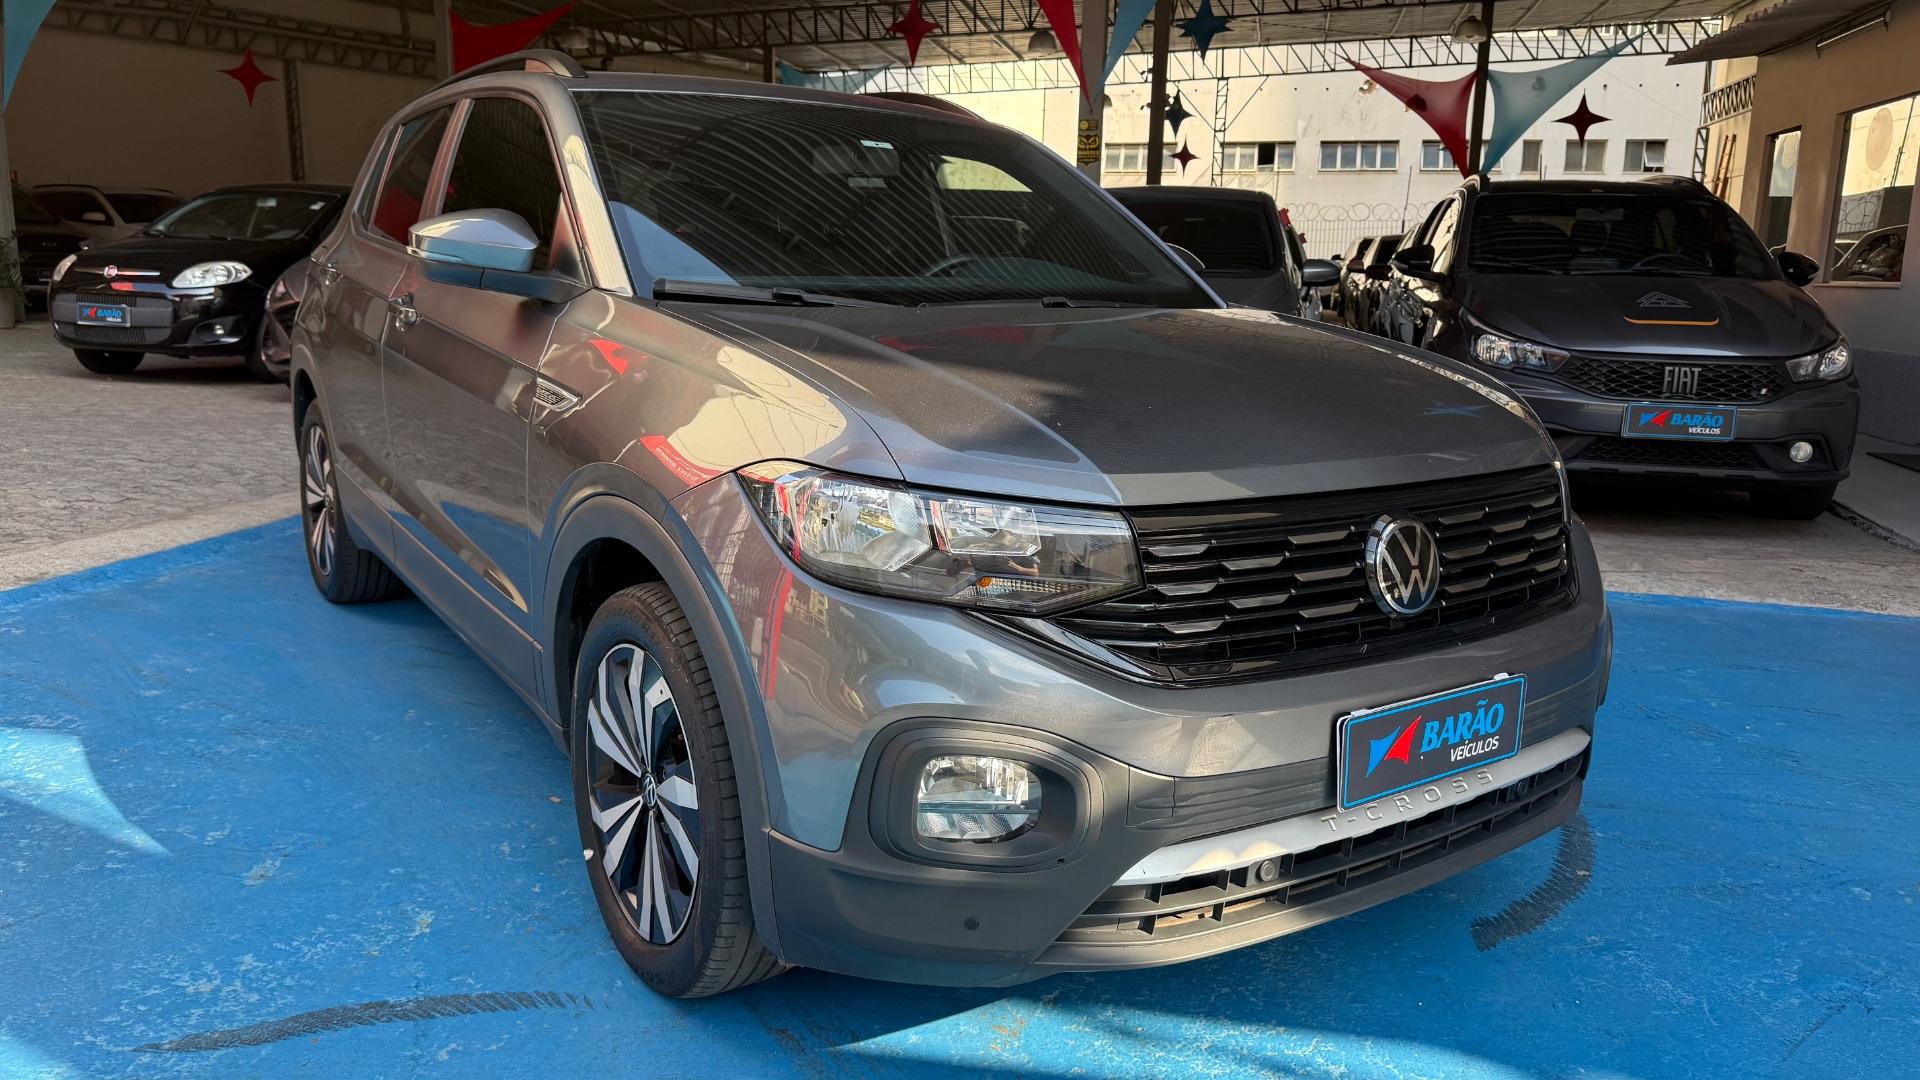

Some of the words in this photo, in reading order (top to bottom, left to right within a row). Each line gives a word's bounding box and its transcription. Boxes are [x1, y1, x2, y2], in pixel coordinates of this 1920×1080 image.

[1662, 366, 1702, 394] FIAT
[1671, 412, 1724, 428] BARÃO
[1688, 426, 1721, 435] VEÍCULOS
[1420, 699, 1505, 753] BARÃO
[1450, 736, 1500, 762] VEÍCULOS
[1320, 768, 1493, 832] T-CROSS
